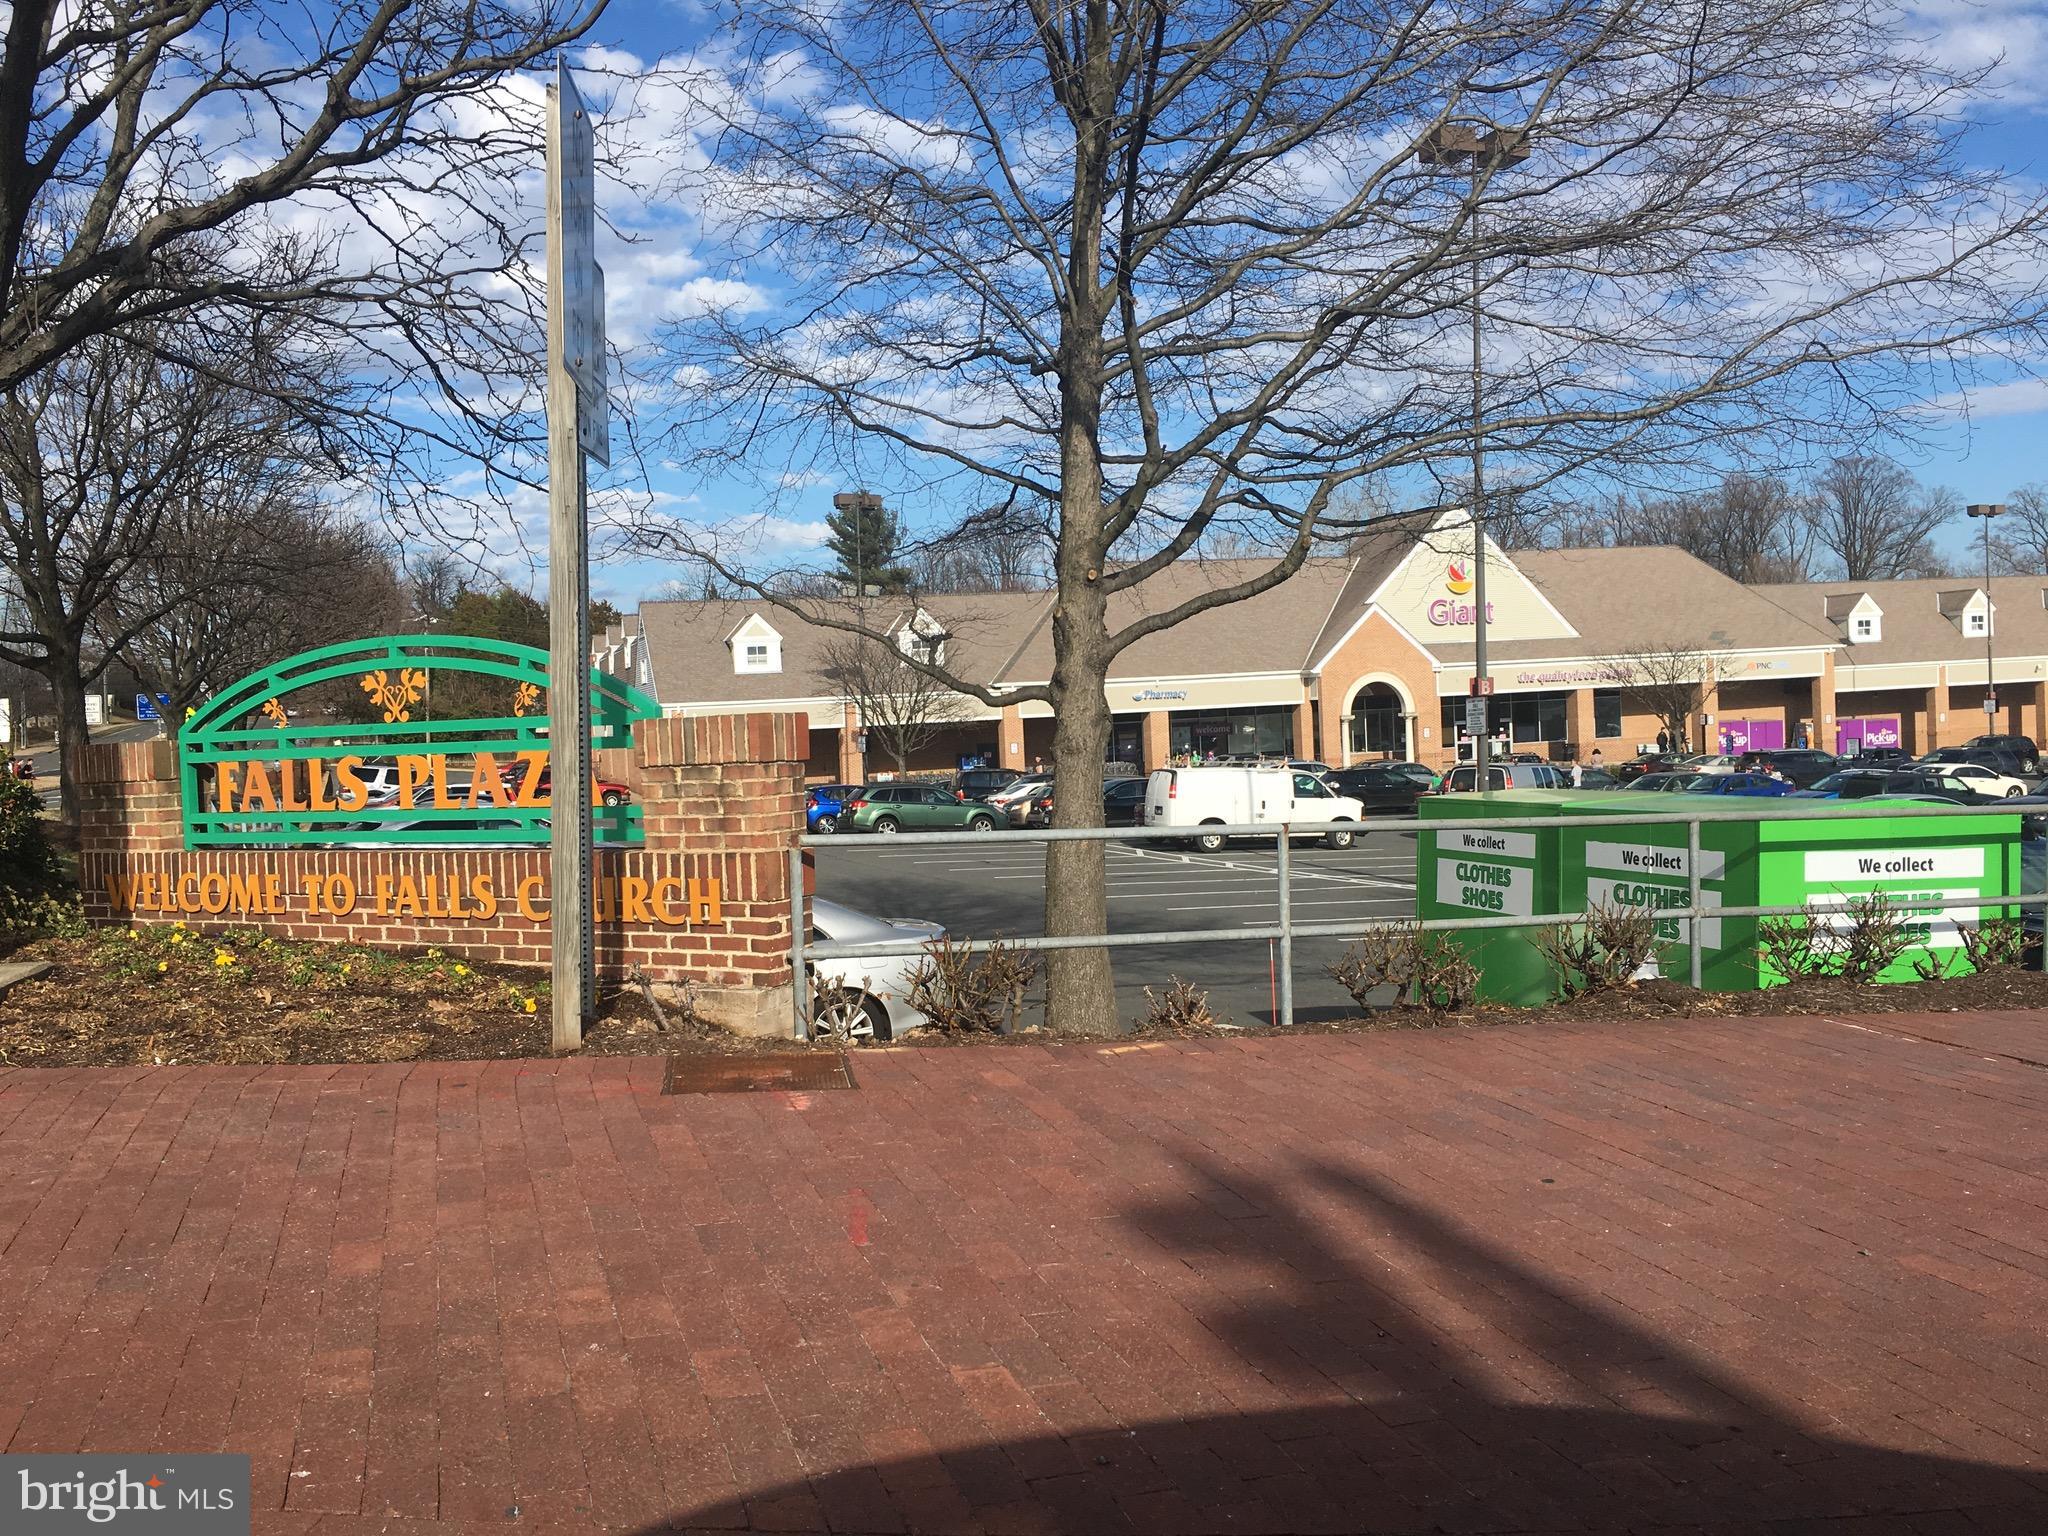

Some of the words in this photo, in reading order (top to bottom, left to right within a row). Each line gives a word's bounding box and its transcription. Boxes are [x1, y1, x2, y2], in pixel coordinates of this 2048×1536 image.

[1756, 661, 1772, 669] PNC
[1518, 672, 1536, 684] the
[1144, 689, 1187, 700] Pharmacy
[1481, 680, 1490, 695] B
[1195, 725, 1231, 734] welcome
[1867, 732, 1897, 743] Pick-up
[216, 754, 369, 813] FALLS
[396, 750, 604, 810] PLAZ
[1463, 834, 1475, 847] We
[1477, 836, 1505, 850] collect
[1623, 851, 1640, 865] We
[1642, 853, 1682, 869] collect
[1859, 858, 1880, 873] We
[1885, 857, 1934, 872] collect
[1456, 863, 1511, 887] CLOTHES
[105, 872, 286, 915] WELCOME
[301, 873, 356, 917] TO
[376, 874, 498, 920] FALLS
[518, 876, 723, 926] CURCH
[1462, 886, 1504, 910] SHOES
[1613, 883, 1691, 909] CLOTHES
